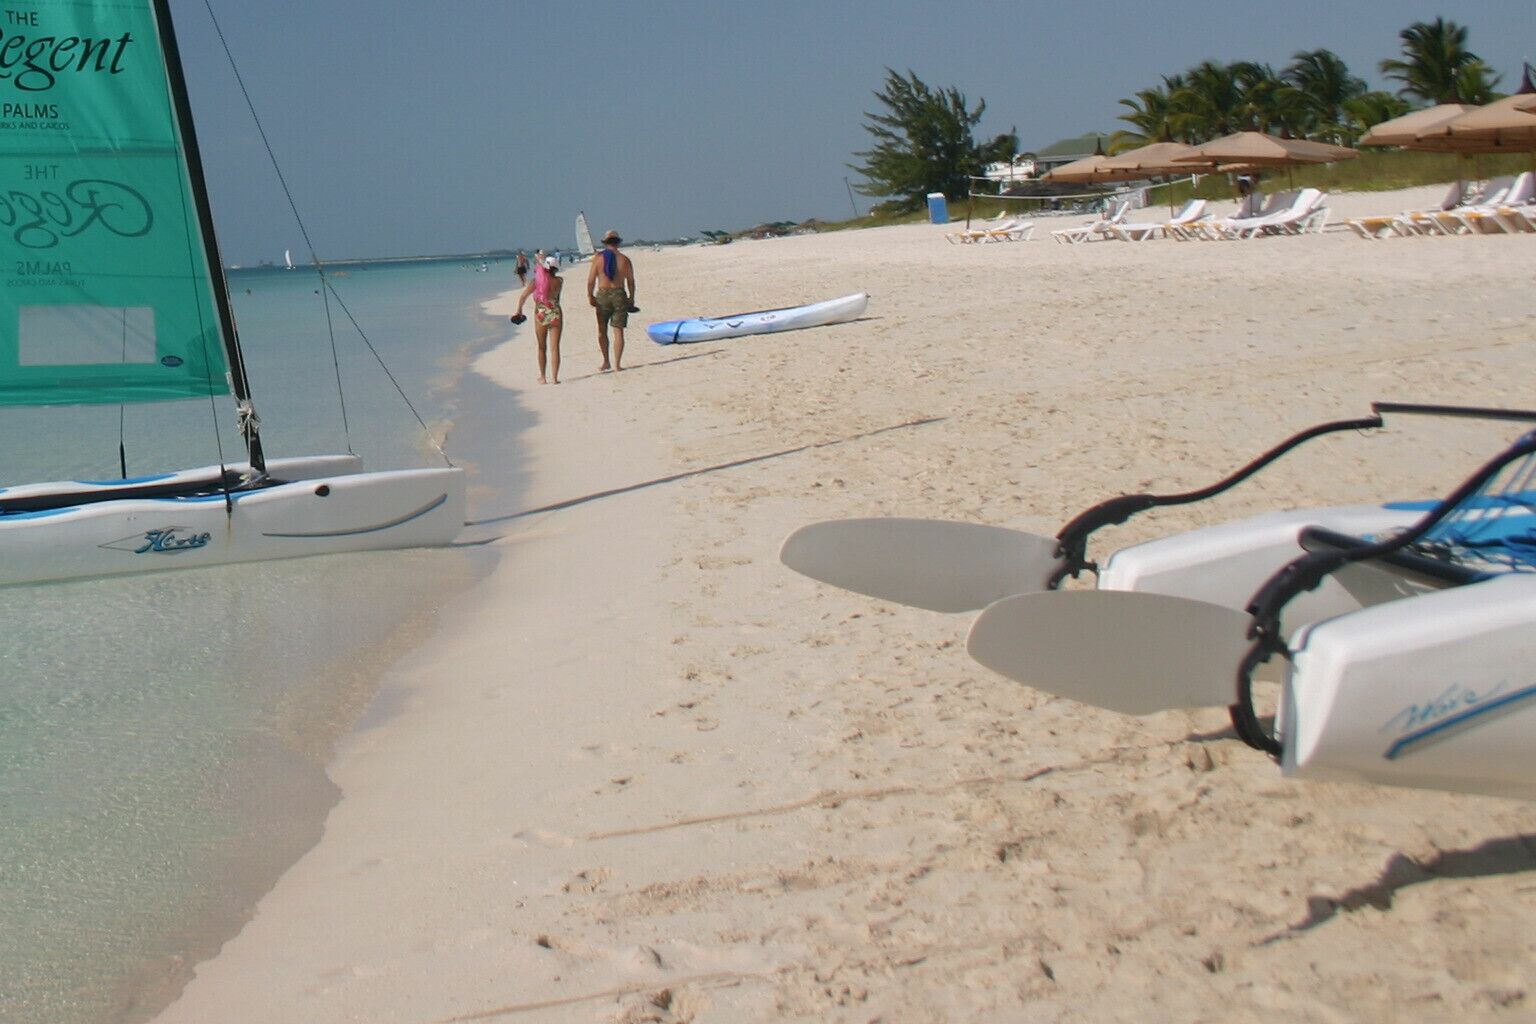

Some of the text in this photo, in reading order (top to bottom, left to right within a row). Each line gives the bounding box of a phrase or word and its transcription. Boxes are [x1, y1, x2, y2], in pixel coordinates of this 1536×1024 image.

[5, 10, 39, 27] THE
[2, 102, 59, 119] PALMS
[18, 121, 38, 130] AND
